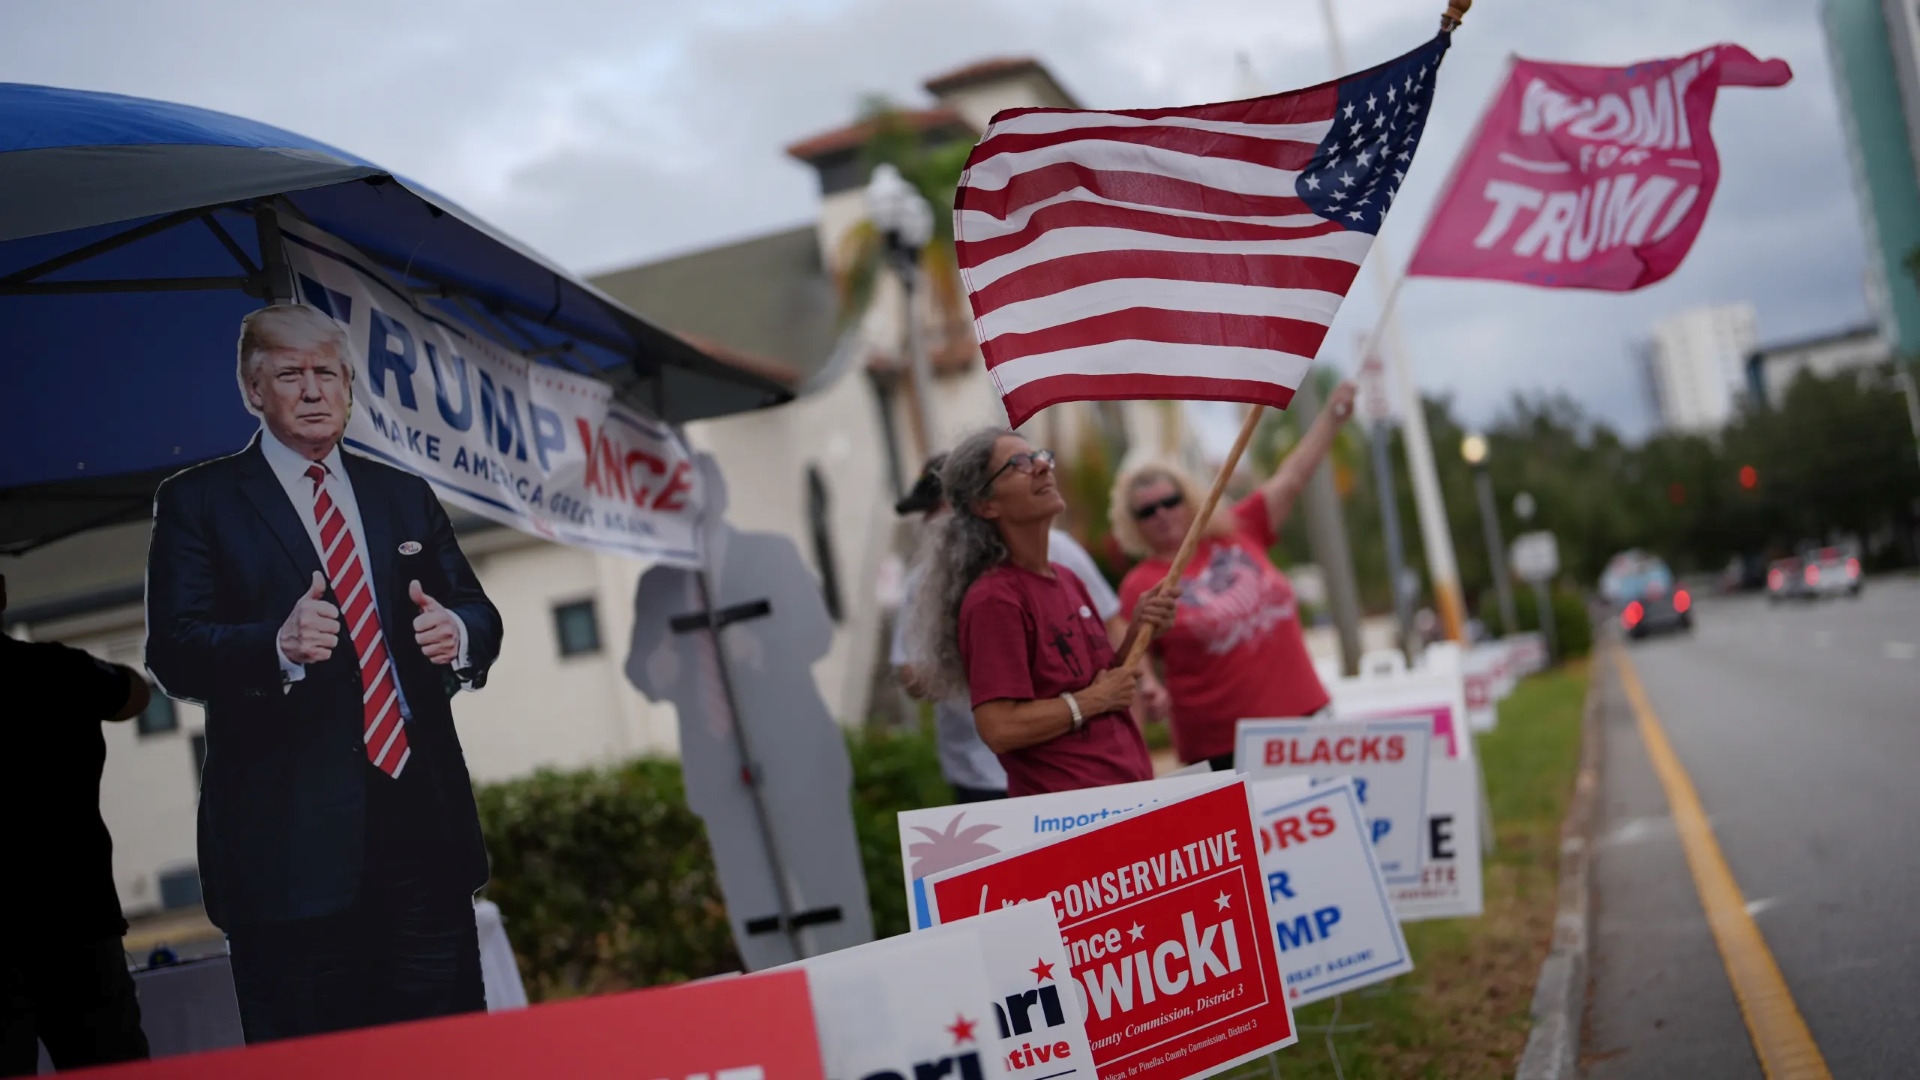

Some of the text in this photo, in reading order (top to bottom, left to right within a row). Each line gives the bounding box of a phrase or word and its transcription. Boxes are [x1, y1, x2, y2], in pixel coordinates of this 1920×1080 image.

[1579, 144, 1653, 172] FOR
[370, 406, 441, 462] MAKE
[1263, 735, 1406, 766] BLACKS
[1046, 828, 1242, 922] CONSERVATIVE
[1062, 927, 1122, 969] ince
[1087, 983, 1244, 1051] ounty Commission, District 3
[1128, 1066, 1138, 1077] for
[1139, 1056, 1165, 1073] Pinellas
[1165, 1047, 1188, 1062] County
[1188, 1036, 1228, 1053] Commission,
[1228, 1024, 1252, 1038] District
[1252, 1019, 1258, 1029] 3
